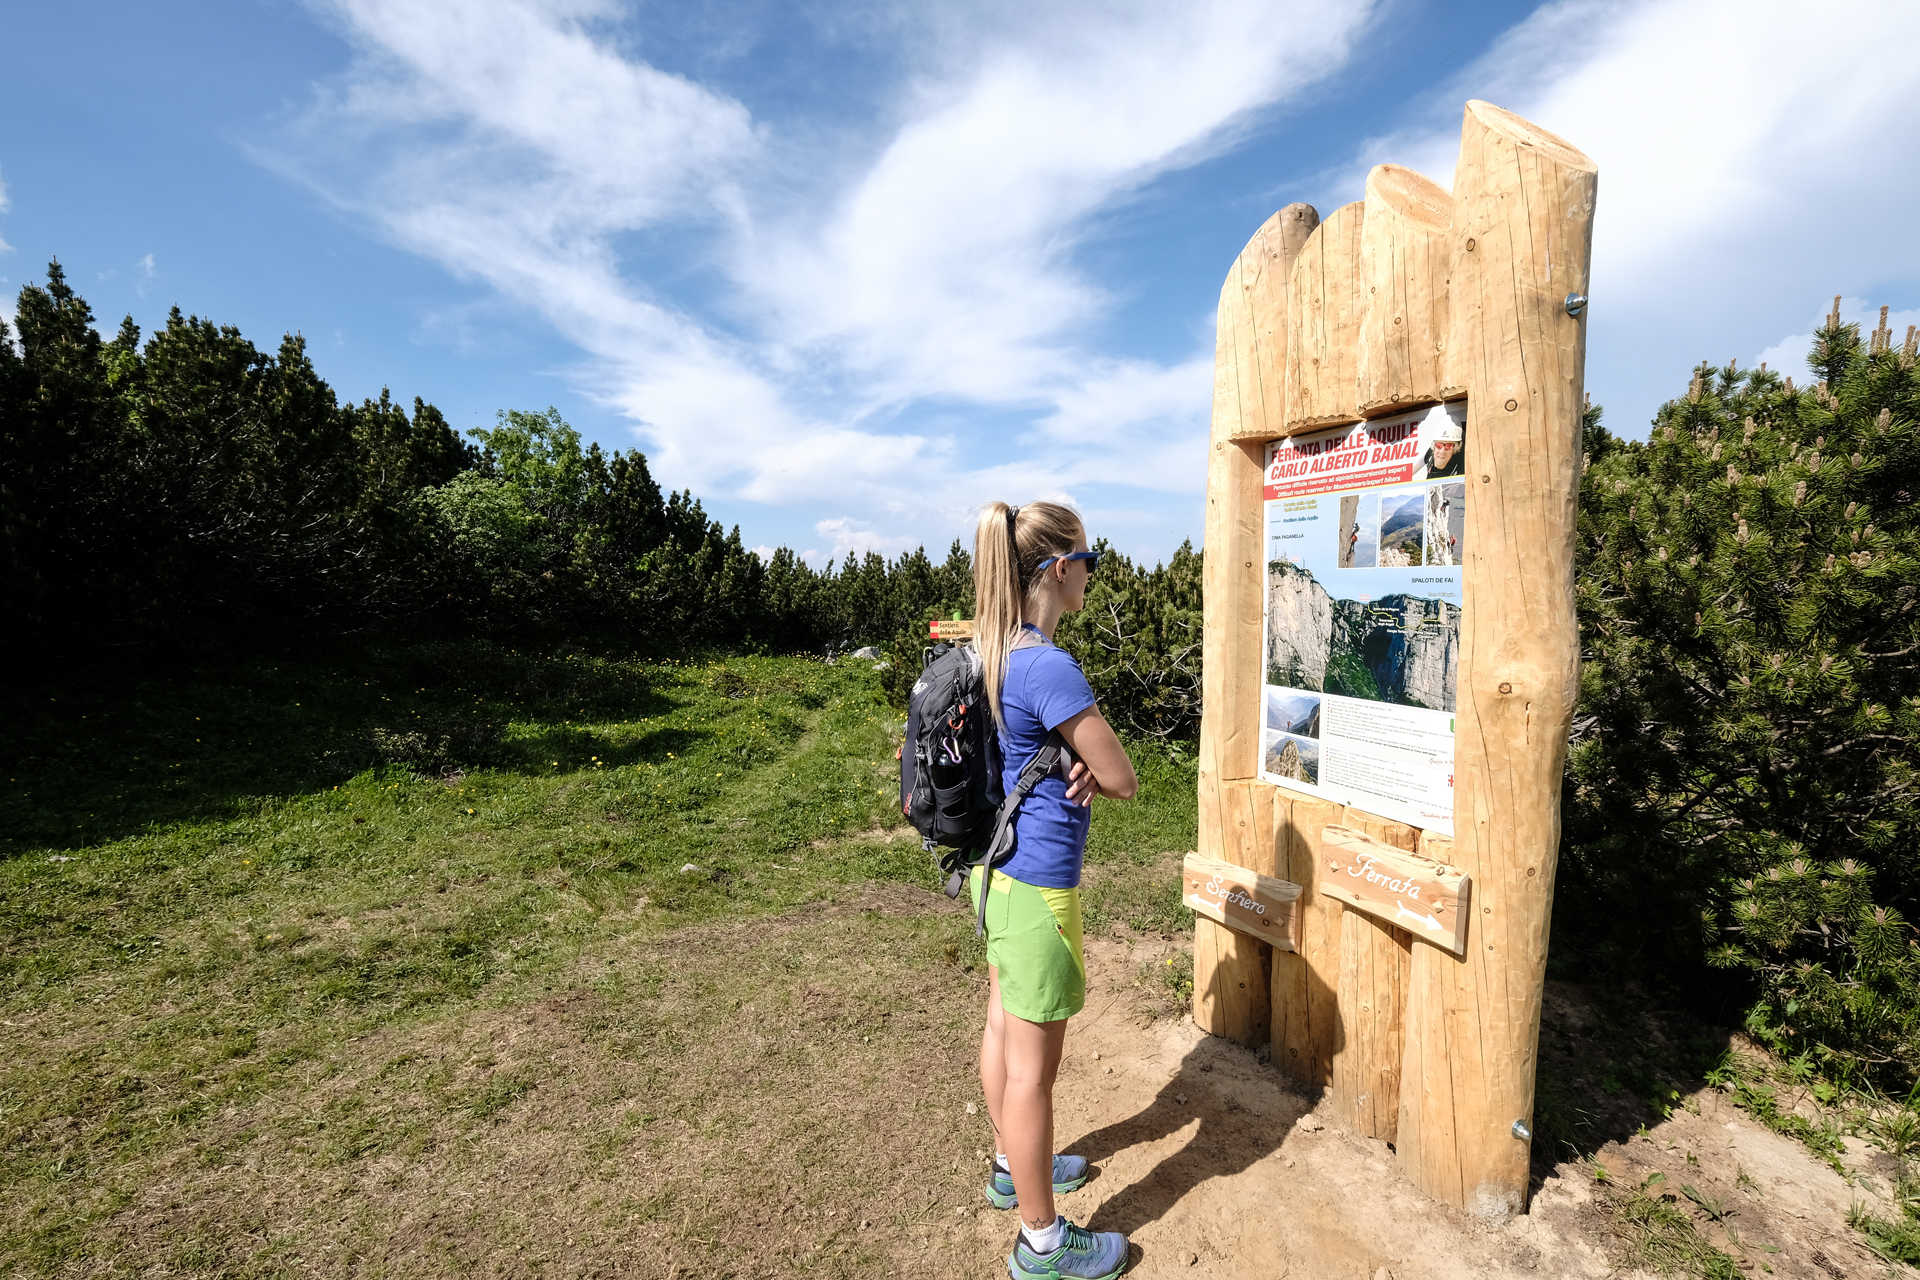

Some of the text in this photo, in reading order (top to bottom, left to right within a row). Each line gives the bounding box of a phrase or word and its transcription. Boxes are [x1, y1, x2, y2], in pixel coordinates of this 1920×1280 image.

[1271, 440, 1419, 480] CARLO ALBERTO BANAL
[1272, 421, 1419, 464] FERRATA DELLE AQUILE
[1388, 465, 1406, 474] esperti
[1206, 874, 1266, 915] Sentiero
[1348, 853, 1420, 899] Ferrata
